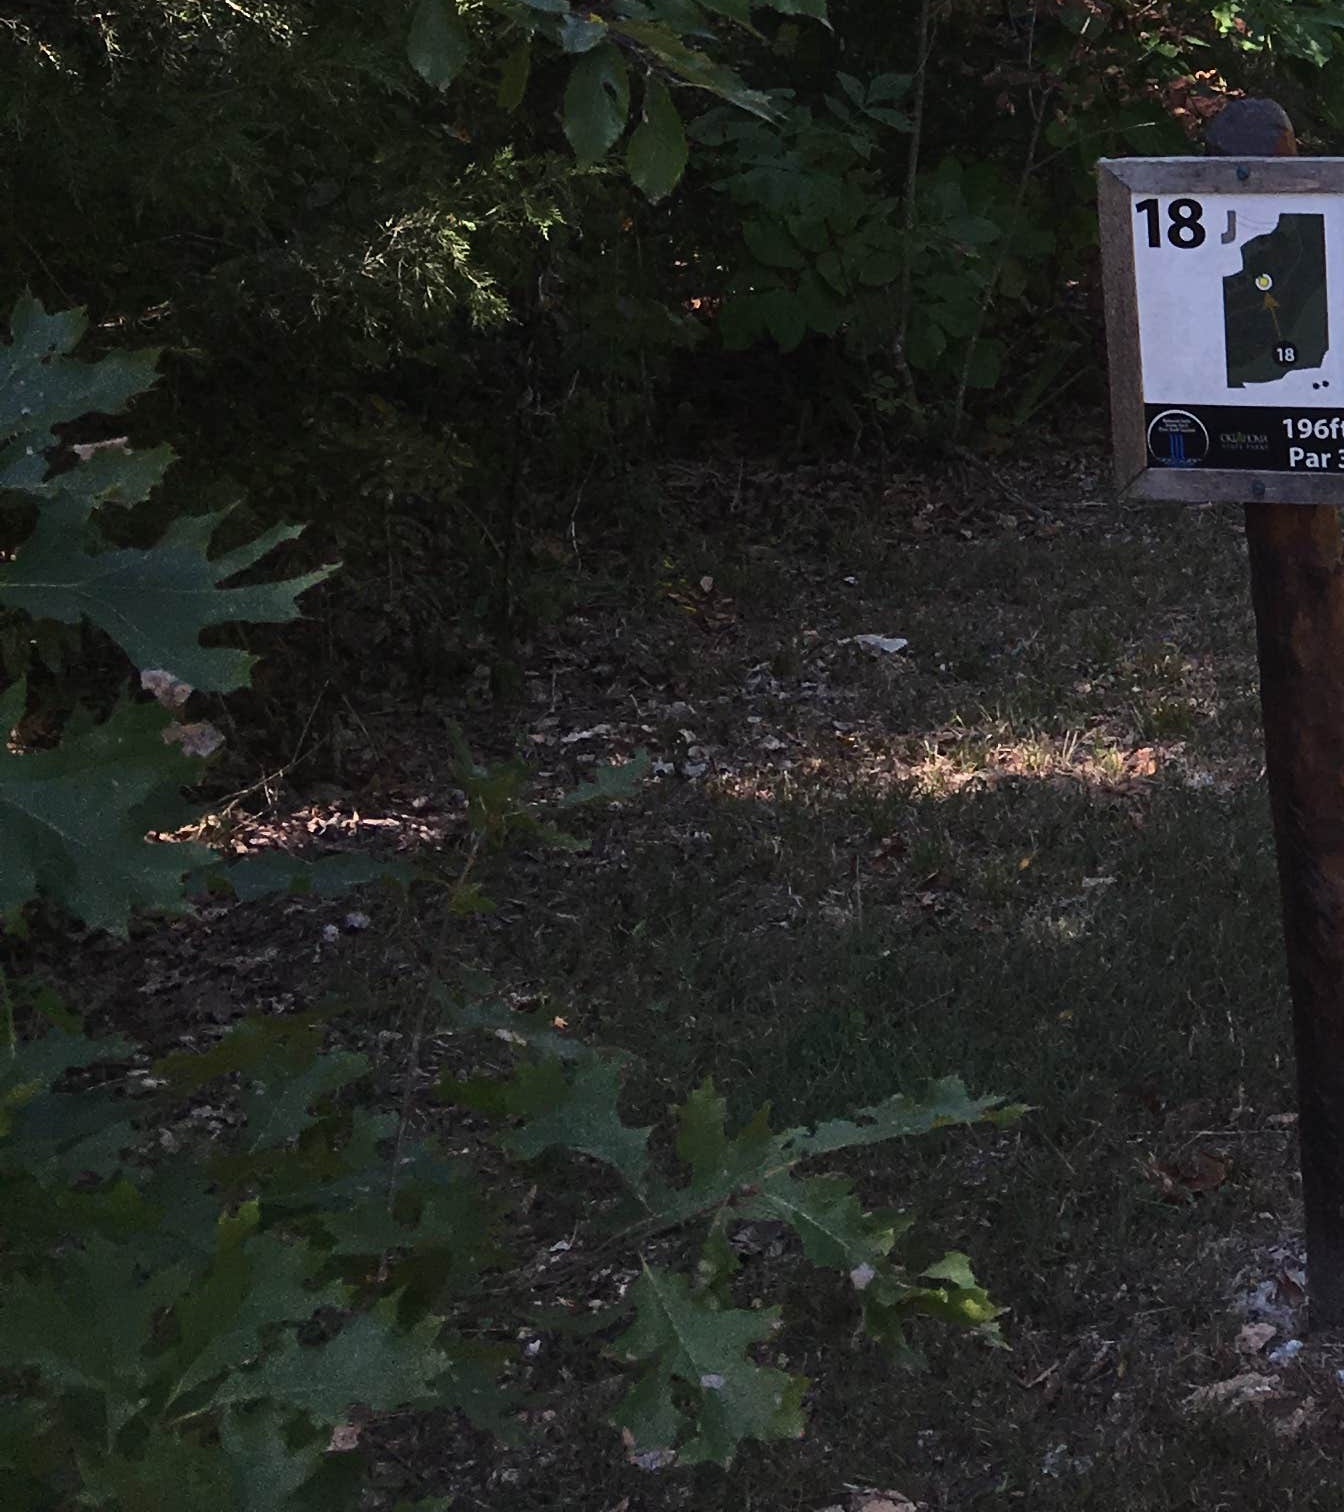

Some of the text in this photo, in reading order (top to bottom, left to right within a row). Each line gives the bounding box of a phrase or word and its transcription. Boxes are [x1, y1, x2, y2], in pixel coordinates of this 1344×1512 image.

[1135, 198, 1206, 249] 18
[1276, 348, 1295, 362] 18
[1289, 446, 1331, 468] Par
